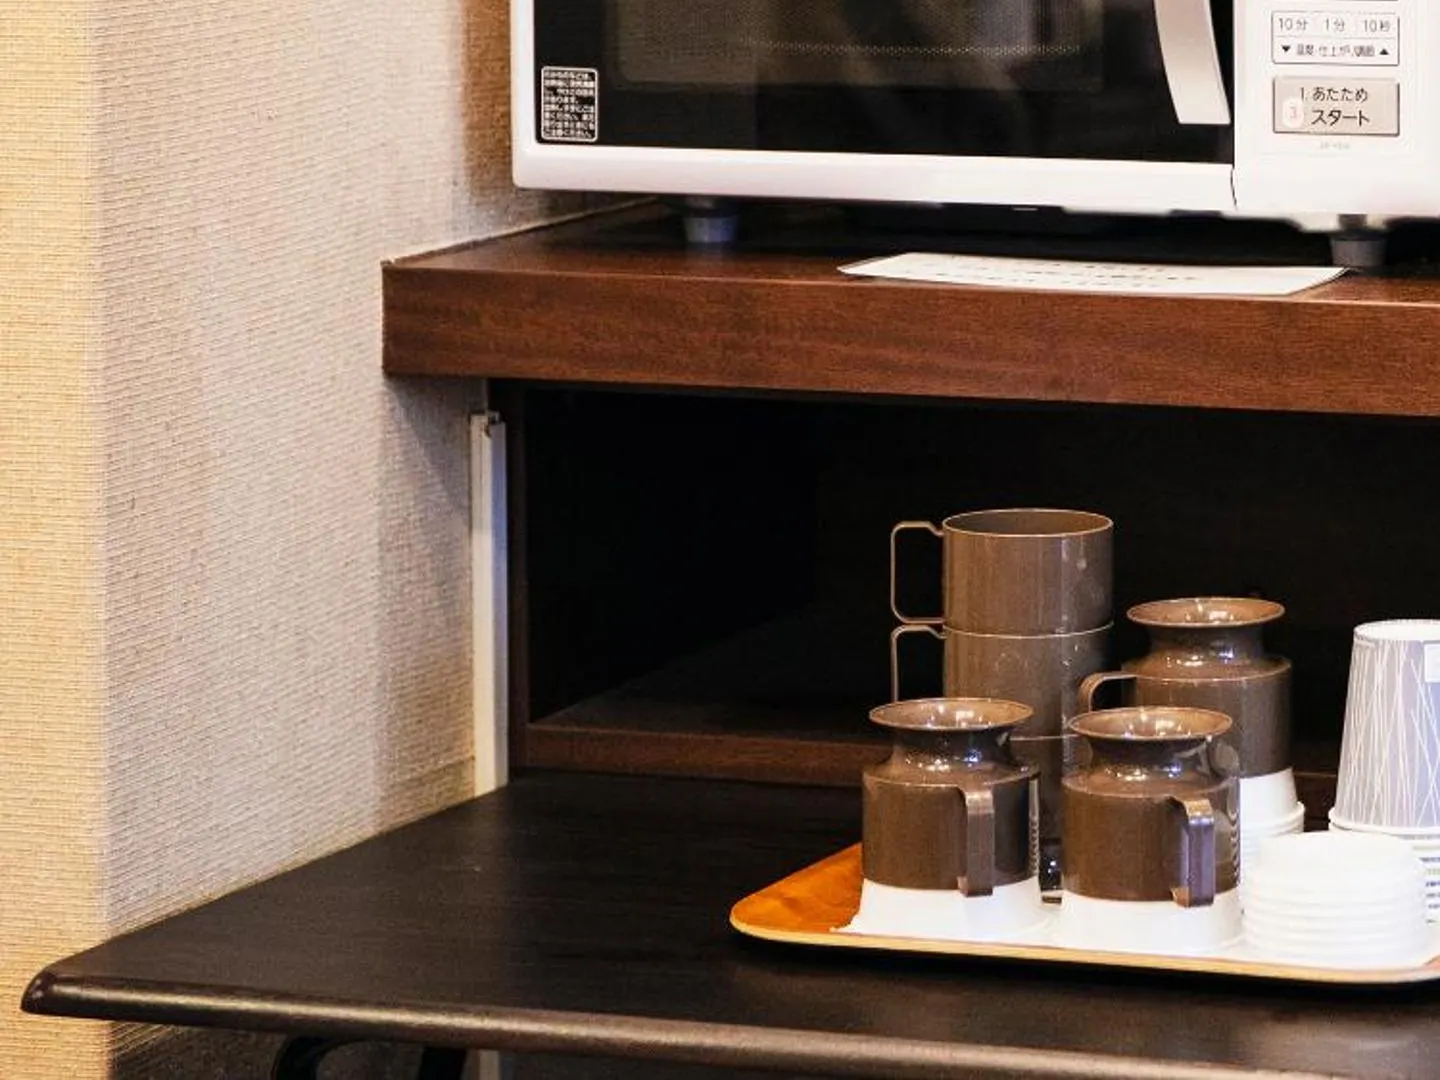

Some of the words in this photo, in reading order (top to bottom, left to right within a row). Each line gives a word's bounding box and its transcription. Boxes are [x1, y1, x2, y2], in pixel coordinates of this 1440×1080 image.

[1278, 17, 1308, 30] 10分
[1311, 109, 1370, 127] スタート
